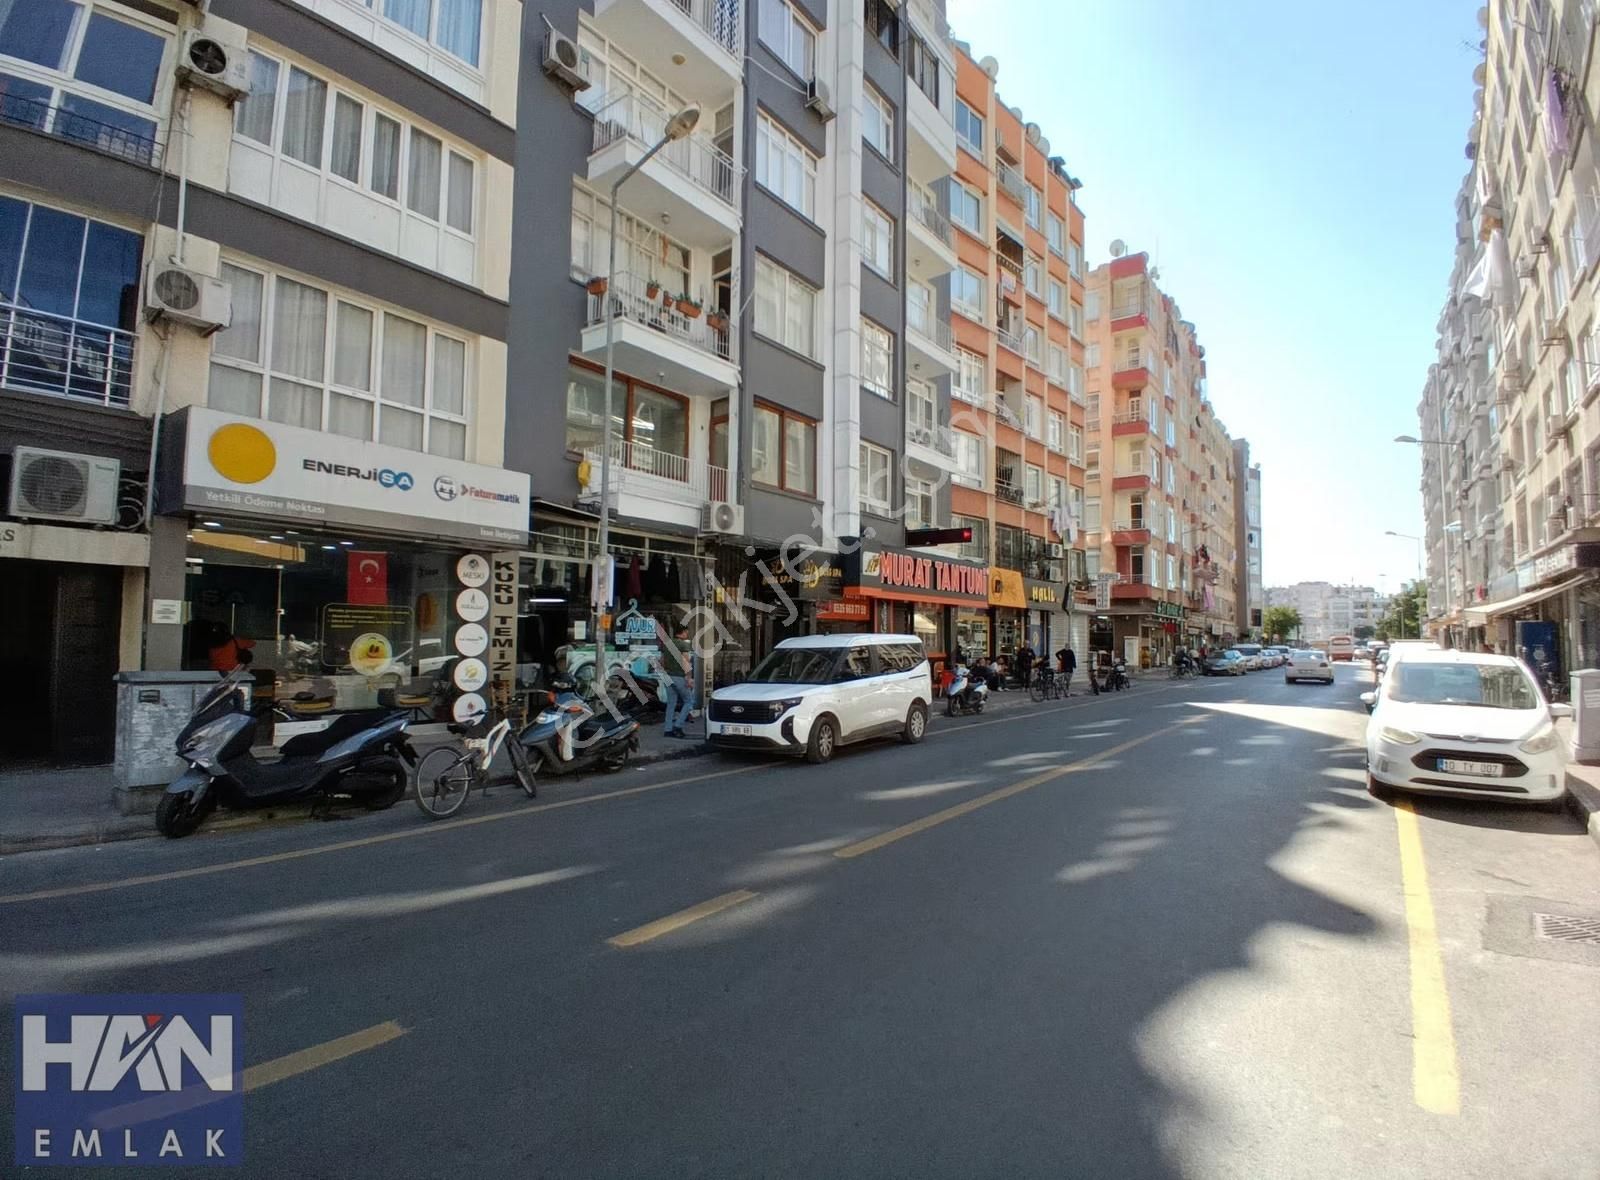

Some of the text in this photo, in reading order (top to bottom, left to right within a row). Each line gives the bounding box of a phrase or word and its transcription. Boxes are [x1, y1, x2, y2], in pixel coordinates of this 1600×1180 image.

[205, 491, 325, 514] Yetkili Ödeme Noktası
[494, 561, 514, 604] KURU
[880, 551, 932, 589] MURAT
[1463, 762, 1474, 771] TY
